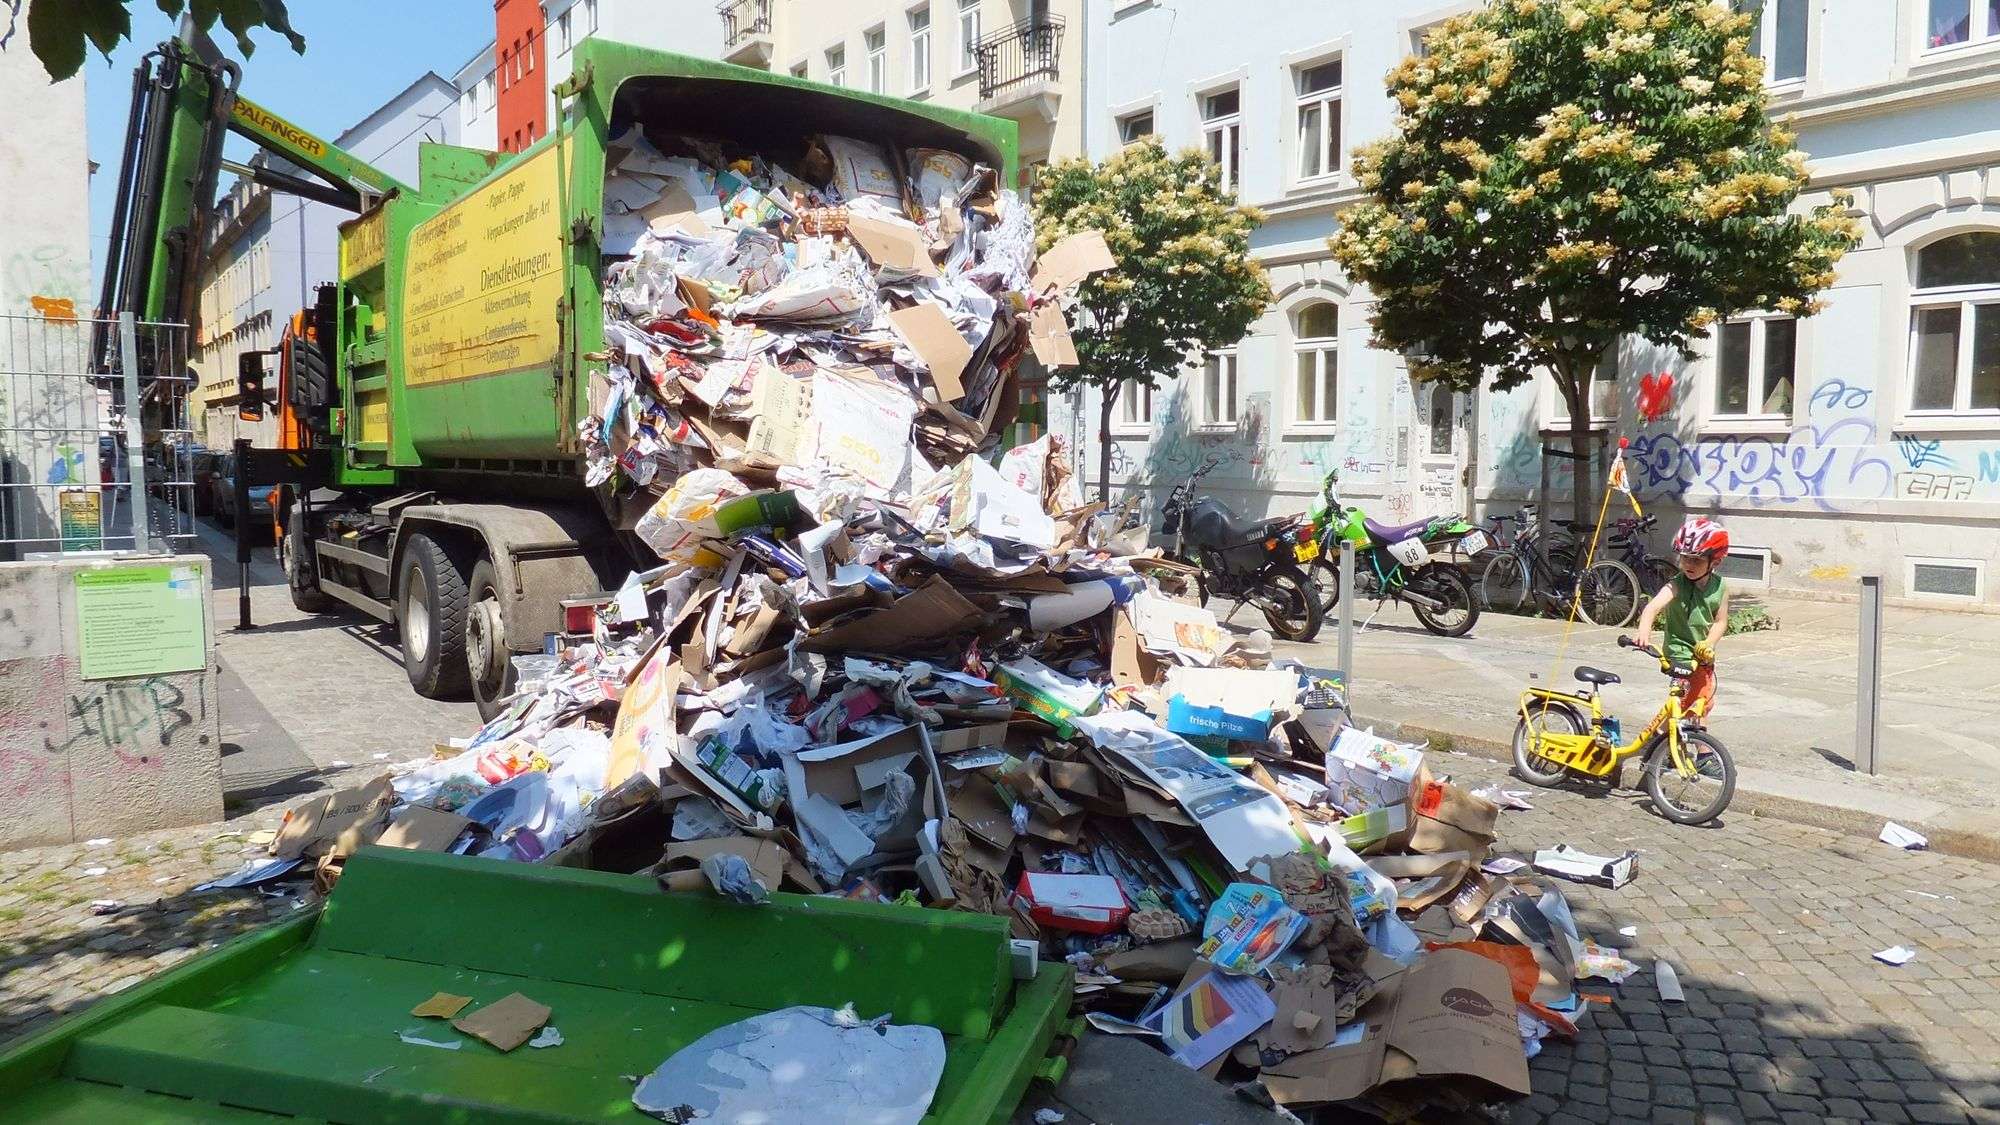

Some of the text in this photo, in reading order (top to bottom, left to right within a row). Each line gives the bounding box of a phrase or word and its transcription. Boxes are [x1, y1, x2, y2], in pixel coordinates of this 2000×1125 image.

[232, 101, 322, 155] PALFINGER
[540, 198, 550, 216] Art
[481, 252, 551, 291] Dienstleistungen:
[1404, 548, 1420, 564] 88
[1189, 715, 1244, 733] frische Pilze
